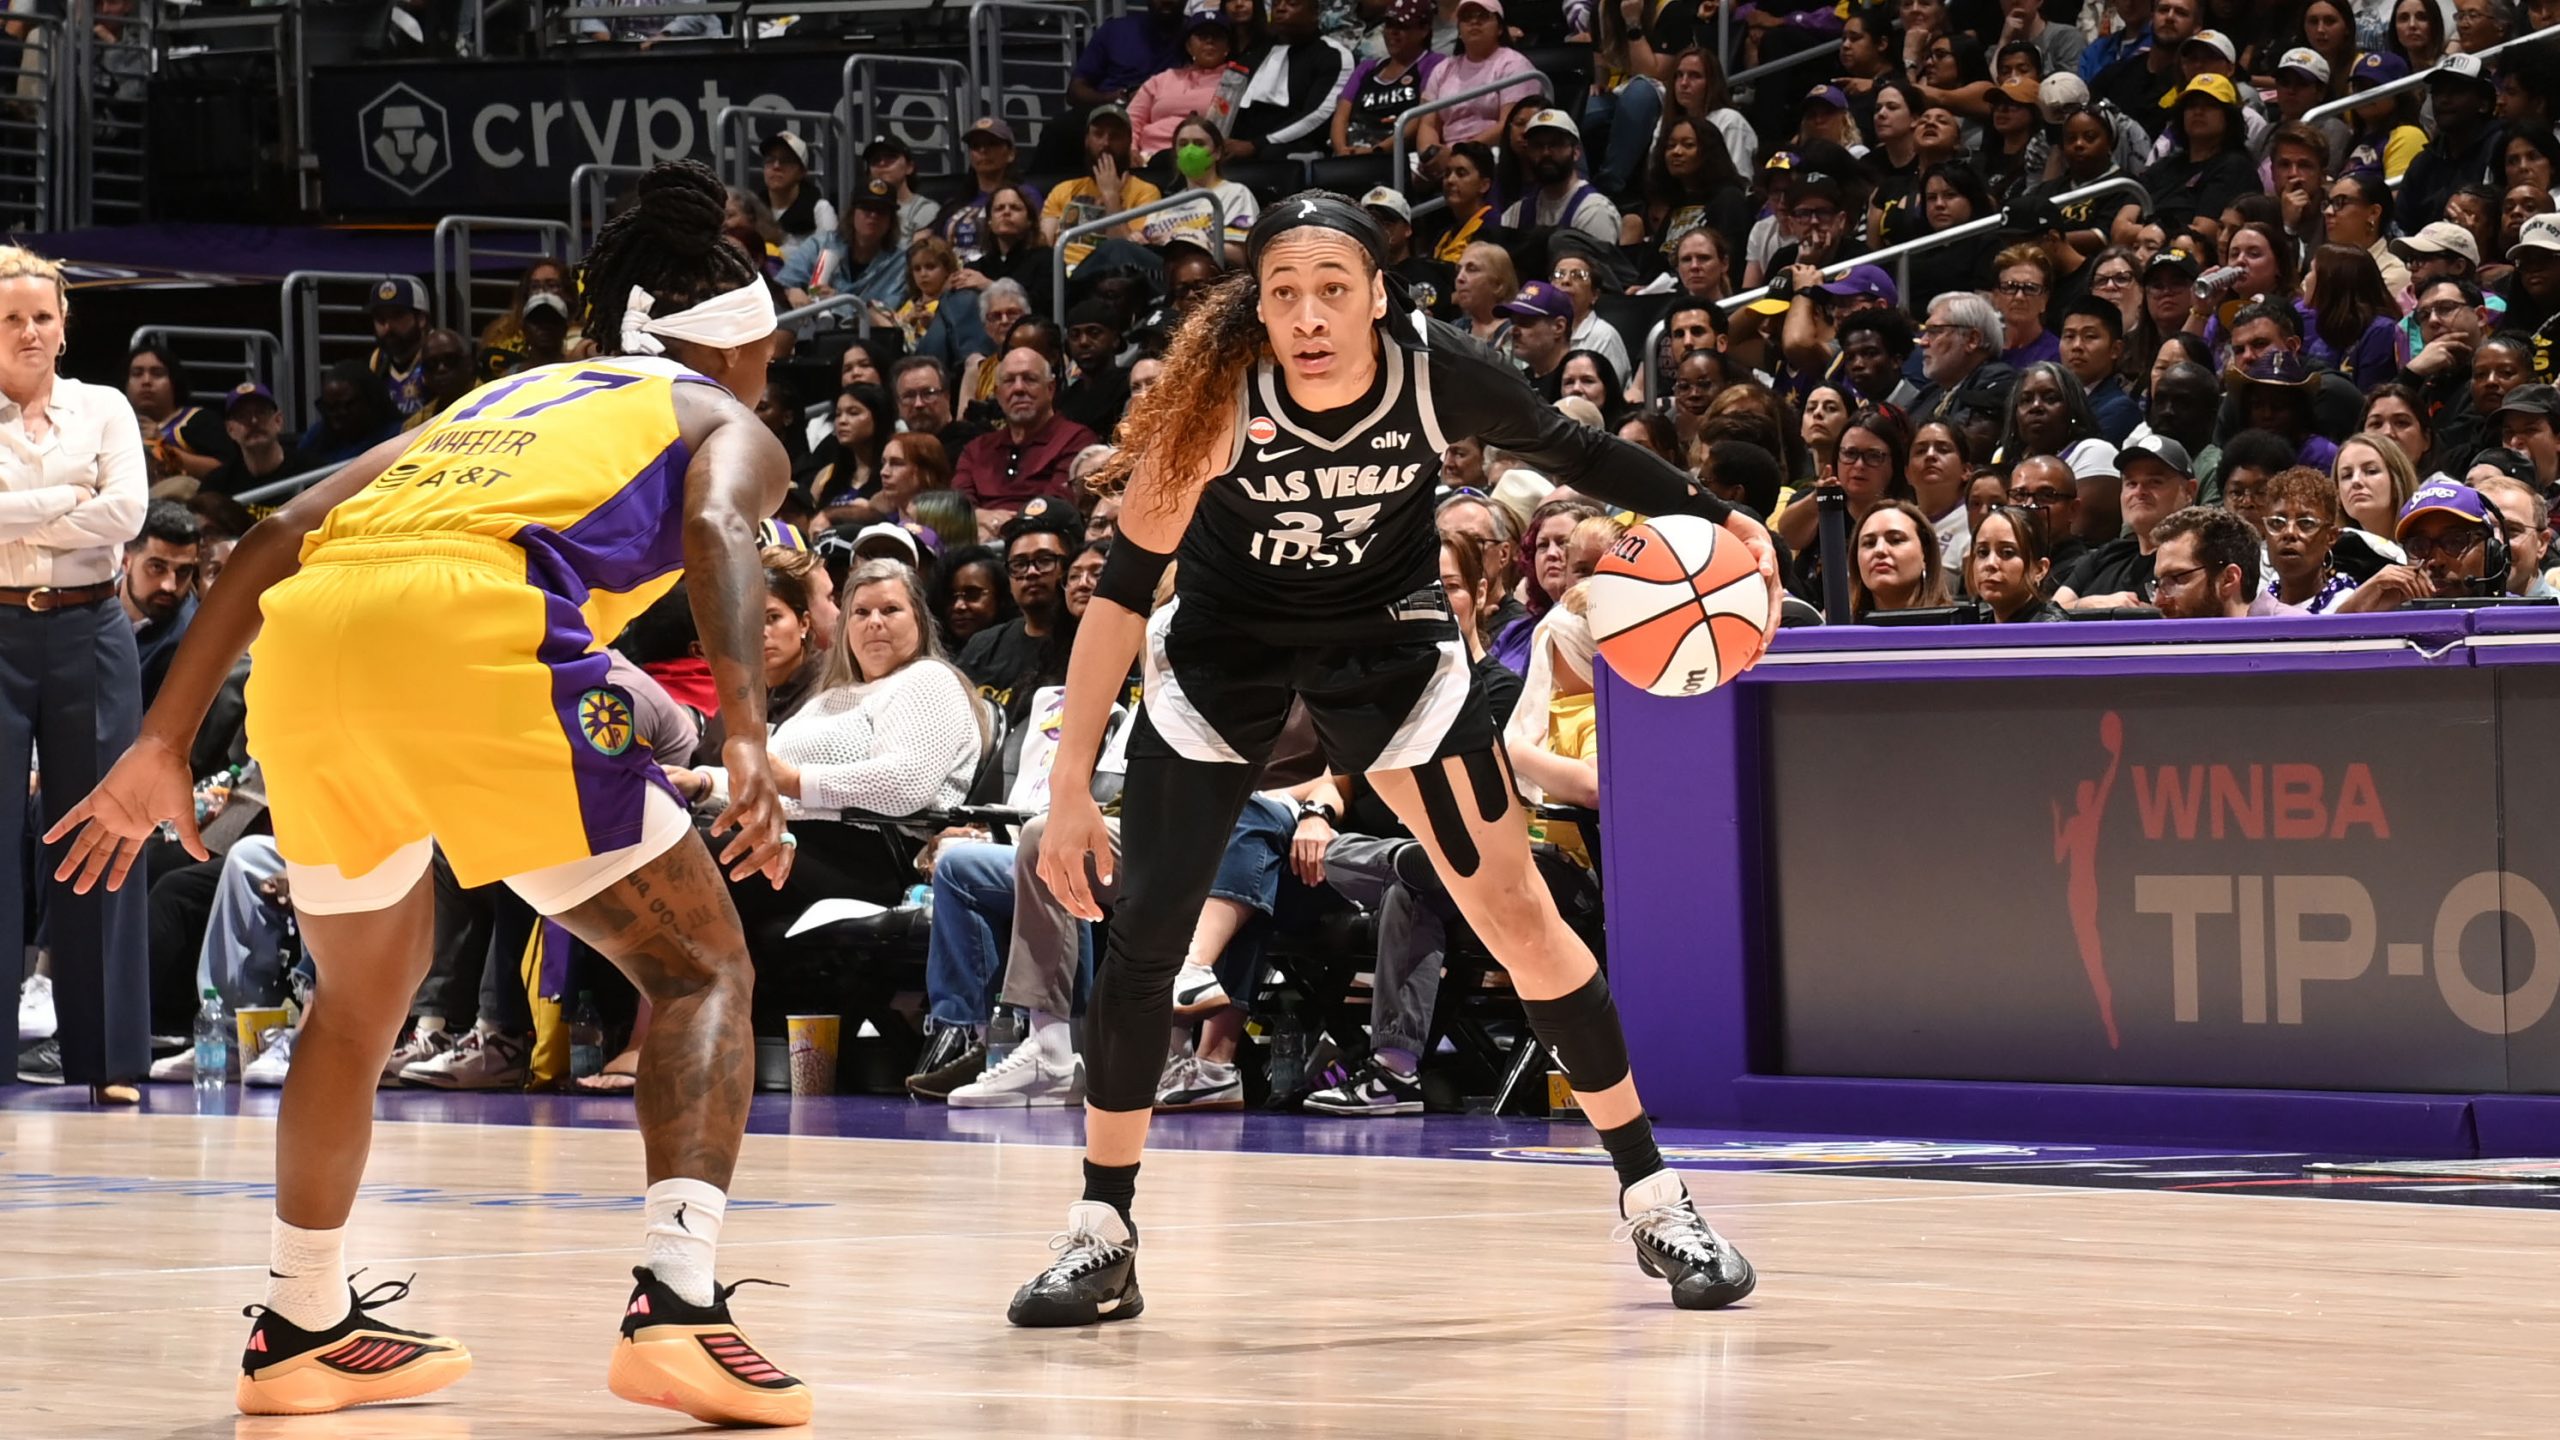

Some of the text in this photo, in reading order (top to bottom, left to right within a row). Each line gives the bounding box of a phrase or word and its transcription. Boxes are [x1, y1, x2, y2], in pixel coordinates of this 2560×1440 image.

[451, 371, 646, 422] 17
[423, 430, 537, 457] WHEELER
[1371, 430, 1412, 450] ally
[1238, 463, 1422, 503] LAS VEGAS
[2131, 763, 2391, 840] WNBA
[2135, 870, 2560, 1035] TIP-O
